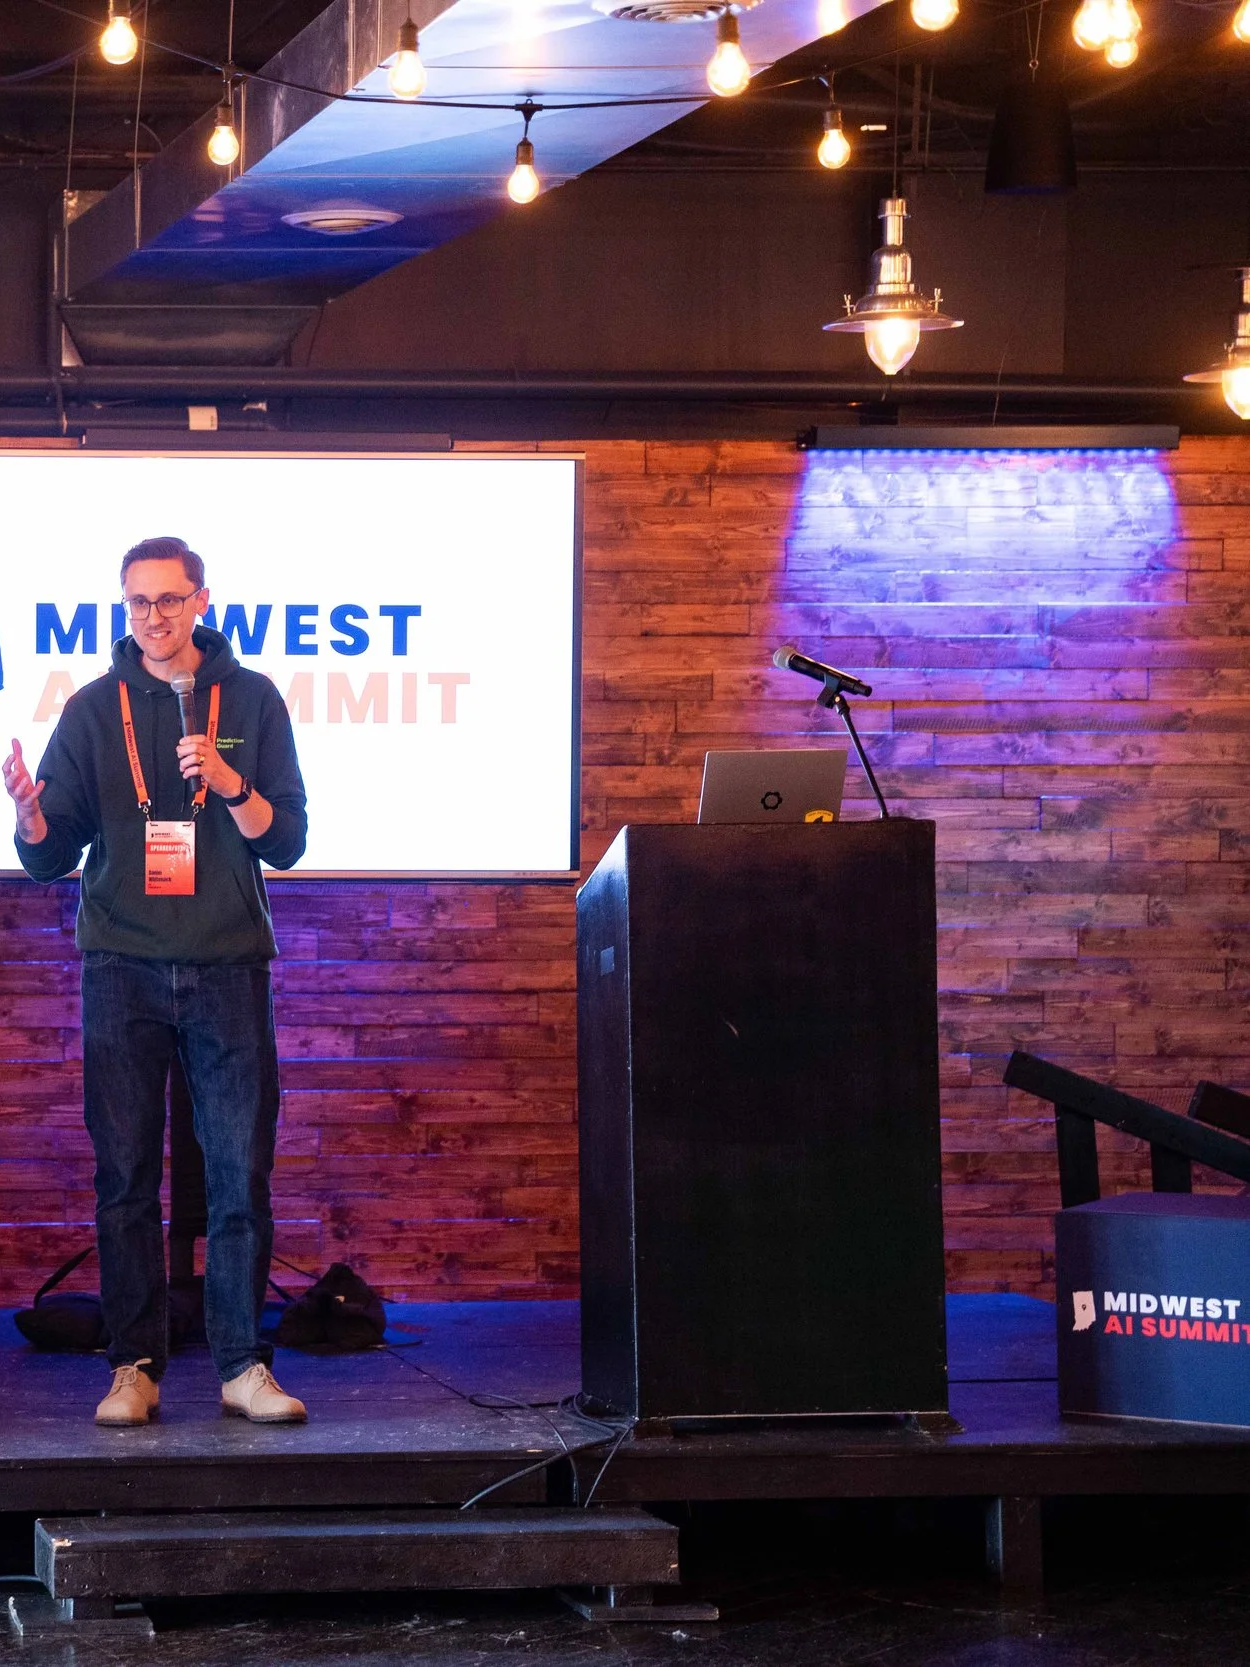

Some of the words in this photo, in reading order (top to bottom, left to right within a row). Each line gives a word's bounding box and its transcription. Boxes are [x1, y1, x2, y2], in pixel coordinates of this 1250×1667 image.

[36, 603, 421, 656] MIWEST
[261, 672, 470, 723] MMIT
[1104, 1291, 1240, 1320] MIDWEST
[1104, 1315, 1133, 1335] AI
[1141, 1317, 1250, 1344] SUMMIT
